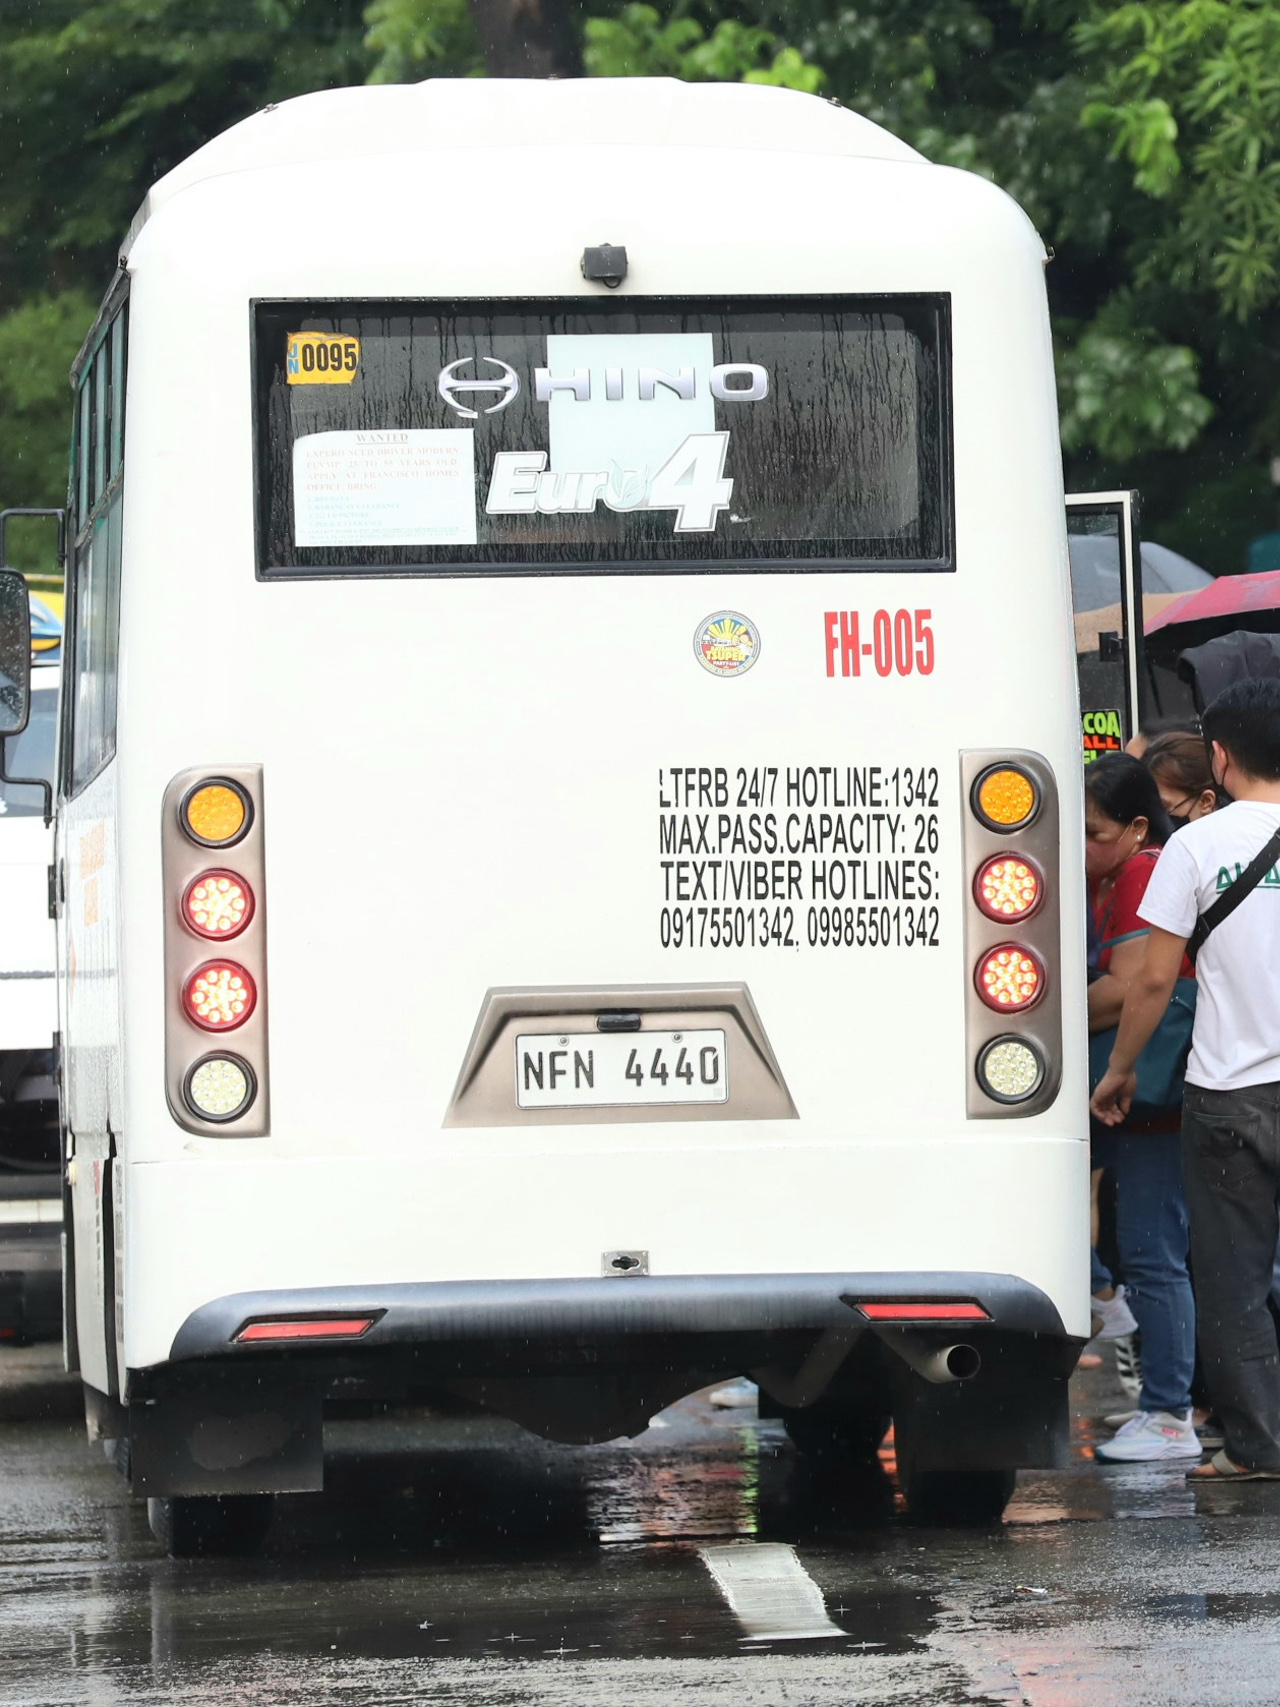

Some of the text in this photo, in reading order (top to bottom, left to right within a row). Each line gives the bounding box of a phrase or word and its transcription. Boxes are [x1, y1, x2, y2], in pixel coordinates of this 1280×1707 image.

[302, 343, 357, 371] 0095
[535, 363, 769, 402] HINO
[356, 433, 408, 443] WANTED
[706, 650, 746, 661] TSUPER
[824, 608, 935, 678] FH-005
[659, 767, 729, 808] LTFRB
[736, 766, 779, 808] 24/7
[914, 813, 940, 854] 26
[660, 859, 940, 901] TEXT/VIBER HOTLINES:
[807, 905, 940, 947] 09985501342
[524, 1046, 719, 1090] NFN 4440
